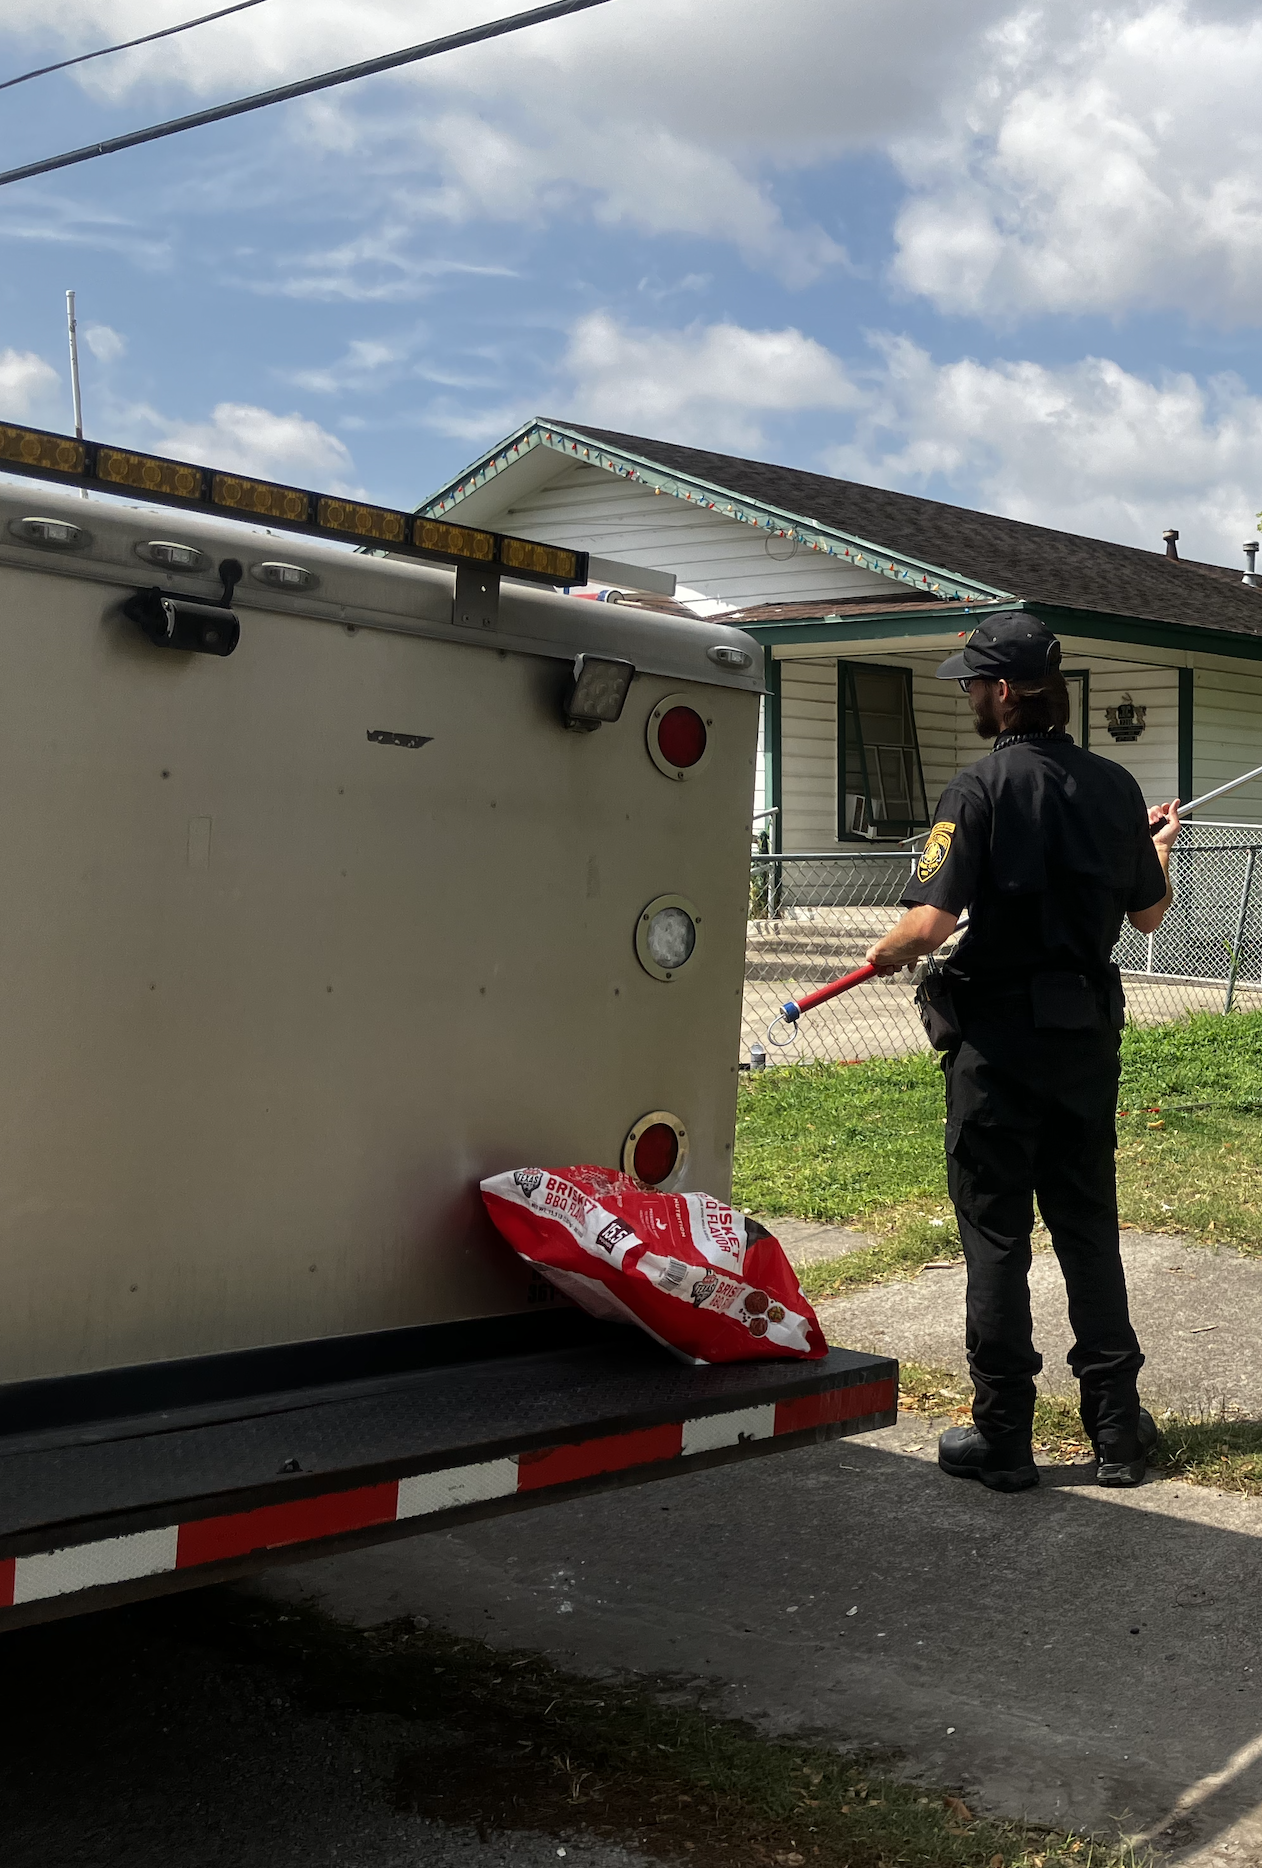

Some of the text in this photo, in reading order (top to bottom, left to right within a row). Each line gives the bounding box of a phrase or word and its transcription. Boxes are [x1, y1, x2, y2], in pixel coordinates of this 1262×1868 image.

[515, 1172, 540, 1186] TEXAS
[544, 1192, 568, 1211] BBQ
[673, 1197, 686, 1238] NUTRITION
[601, 1222, 628, 1244] 15.5
[706, 1214, 731, 1253] FLAVOR
[718, 1204, 740, 1263] ISKET
[695, 1282, 716, 1295] TEXAS
[715, 1281, 746, 1299] BRIST
